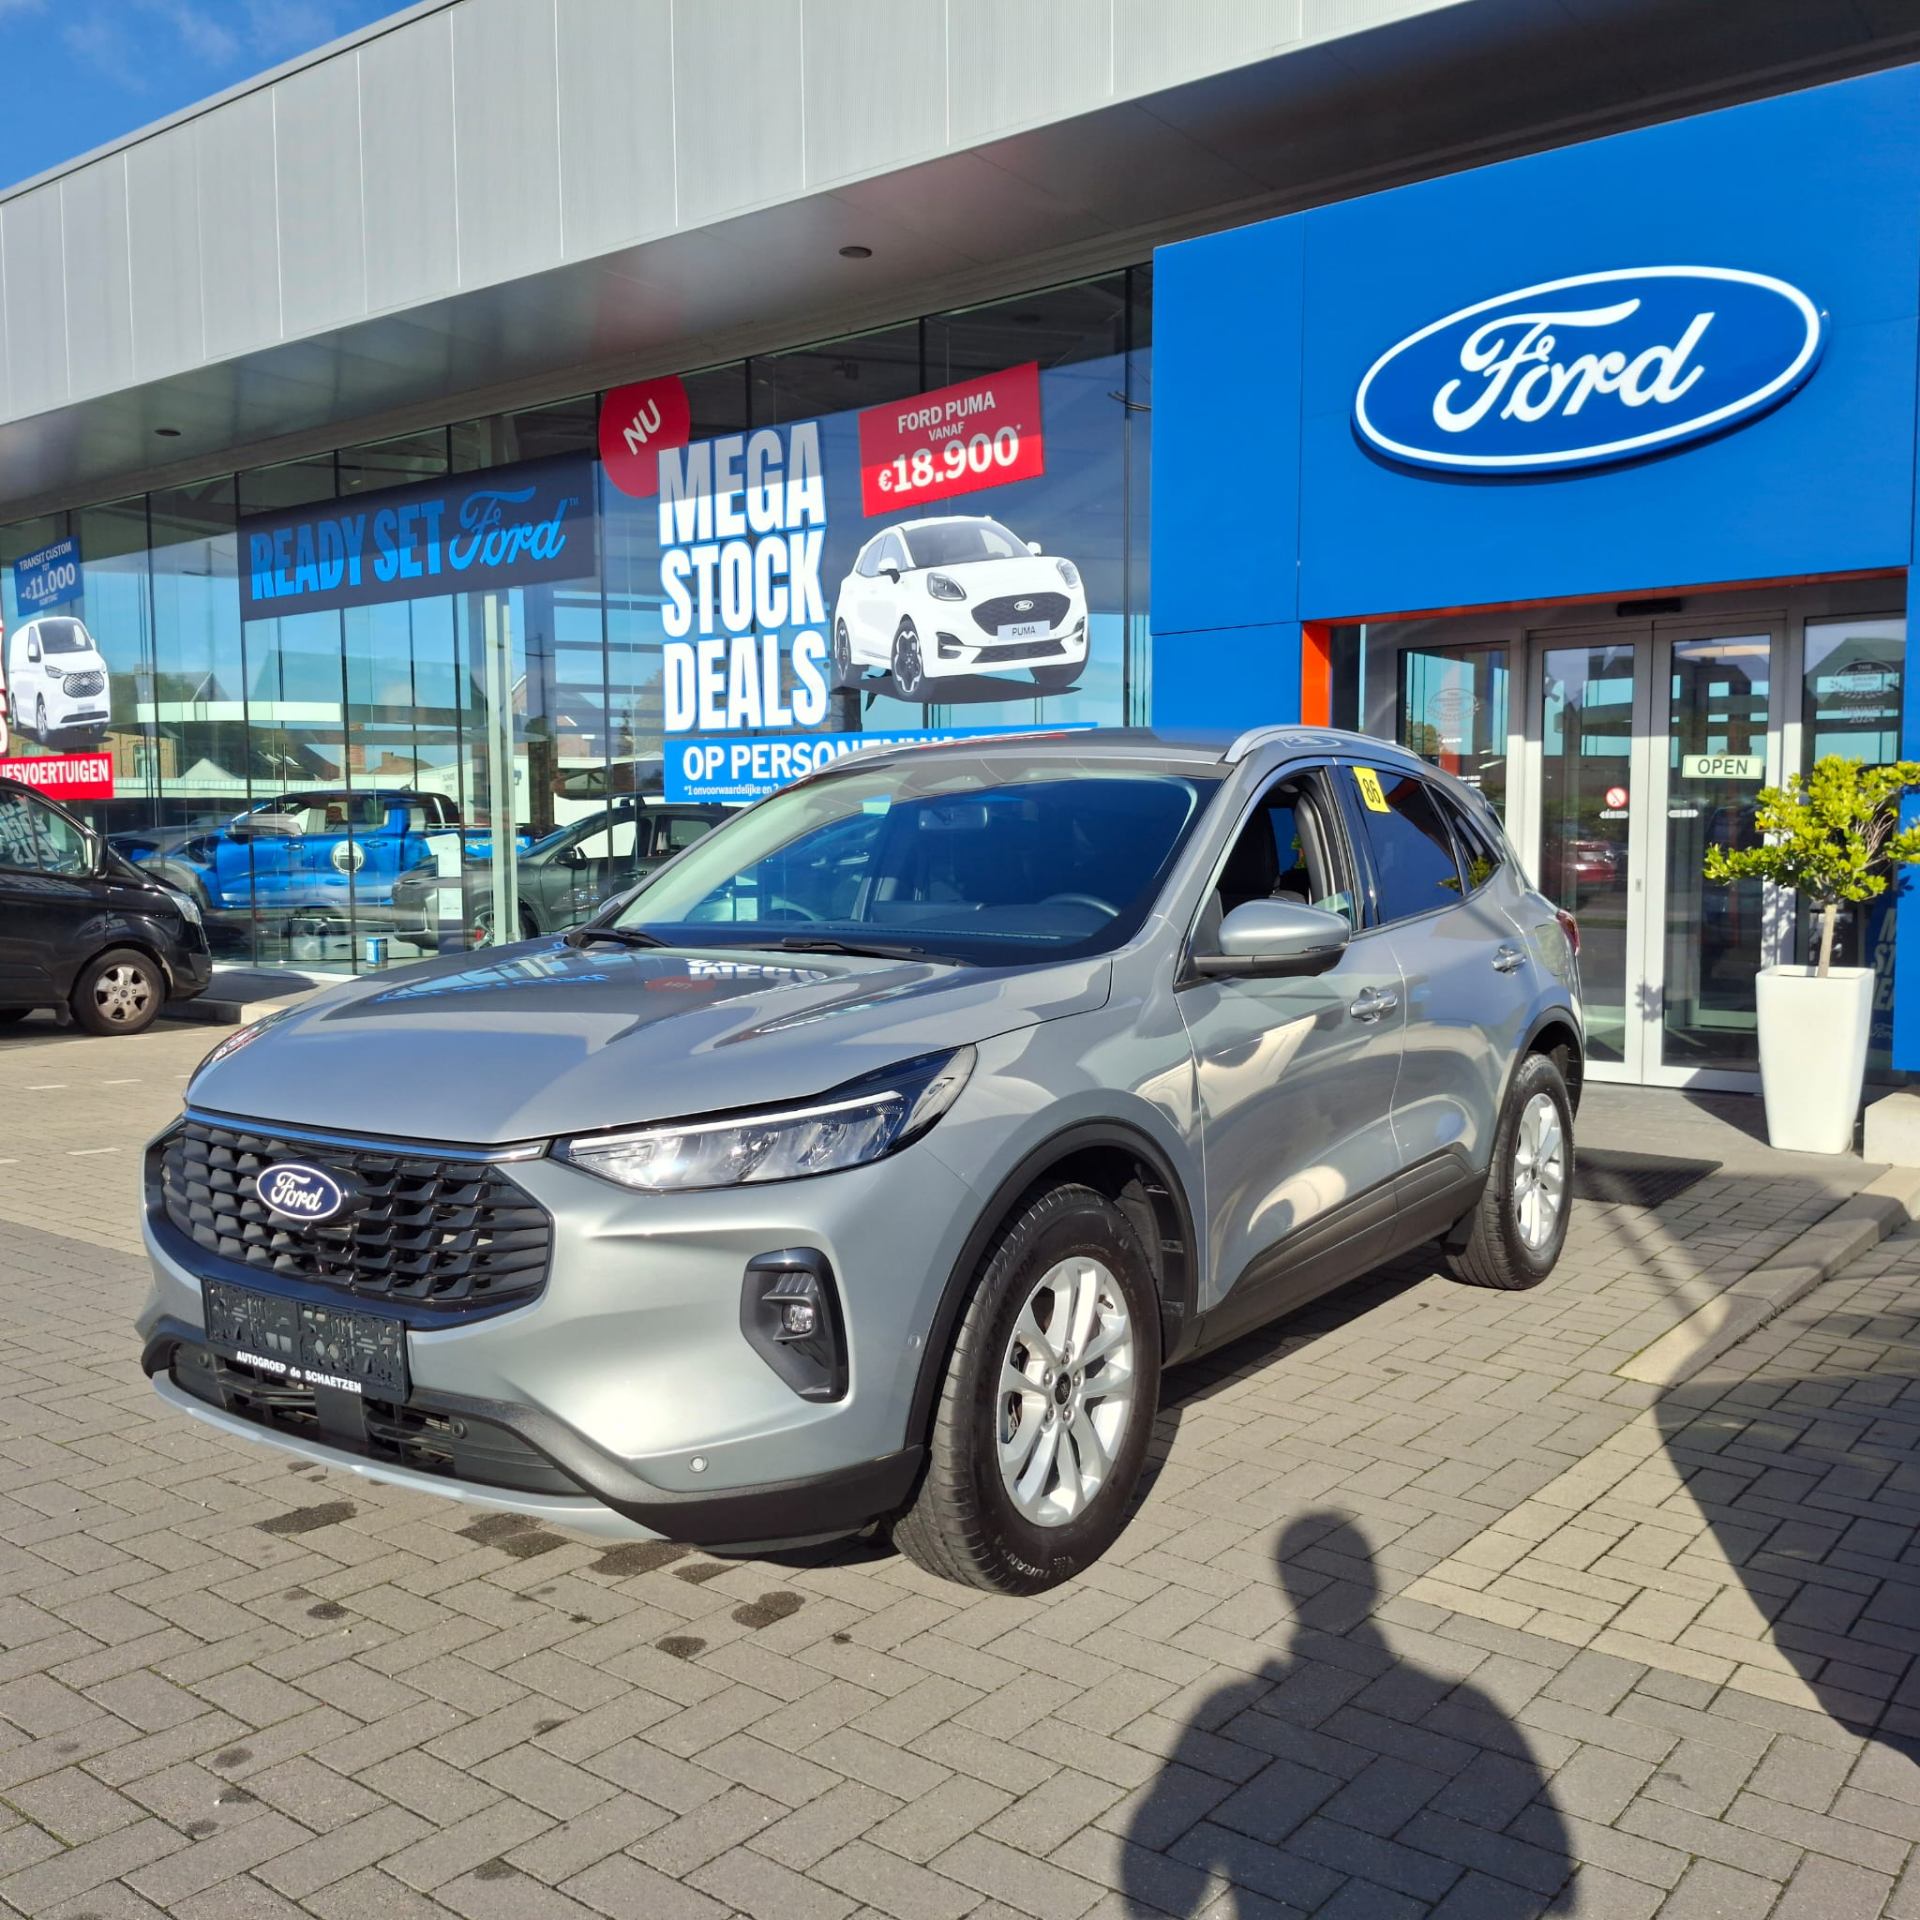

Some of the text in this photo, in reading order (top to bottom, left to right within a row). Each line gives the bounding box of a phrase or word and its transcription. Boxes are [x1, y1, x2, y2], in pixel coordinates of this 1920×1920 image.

[1432, 298, 1716, 432] Ford
[622, 398, 662, 456] NU
[897, 390, 997, 434] FORD PUMA
[928, 421, 965, 441] VANAF
[657, 421, 826, 546] MEGA
[19, 540, 72, 571] TRANSIT CUSTOM
[250, 513, 366, 601] READY
[373, 500, 445, 582] SET
[449, 485, 569, 571] Ford
[660, 529, 826, 638] STOCK
[1011, 625, 1036, 637] PUMA
[663, 629, 829, 733] DEALS
[682, 746, 725, 781] OP
[1697, 758, 1748, 775] OPEN
[1363, 777, 1381, 804] 86
[271, 1171, 324, 1212] Ford
[236, 1350, 362, 1393] AUTOGROEP de SCHAETZEN
